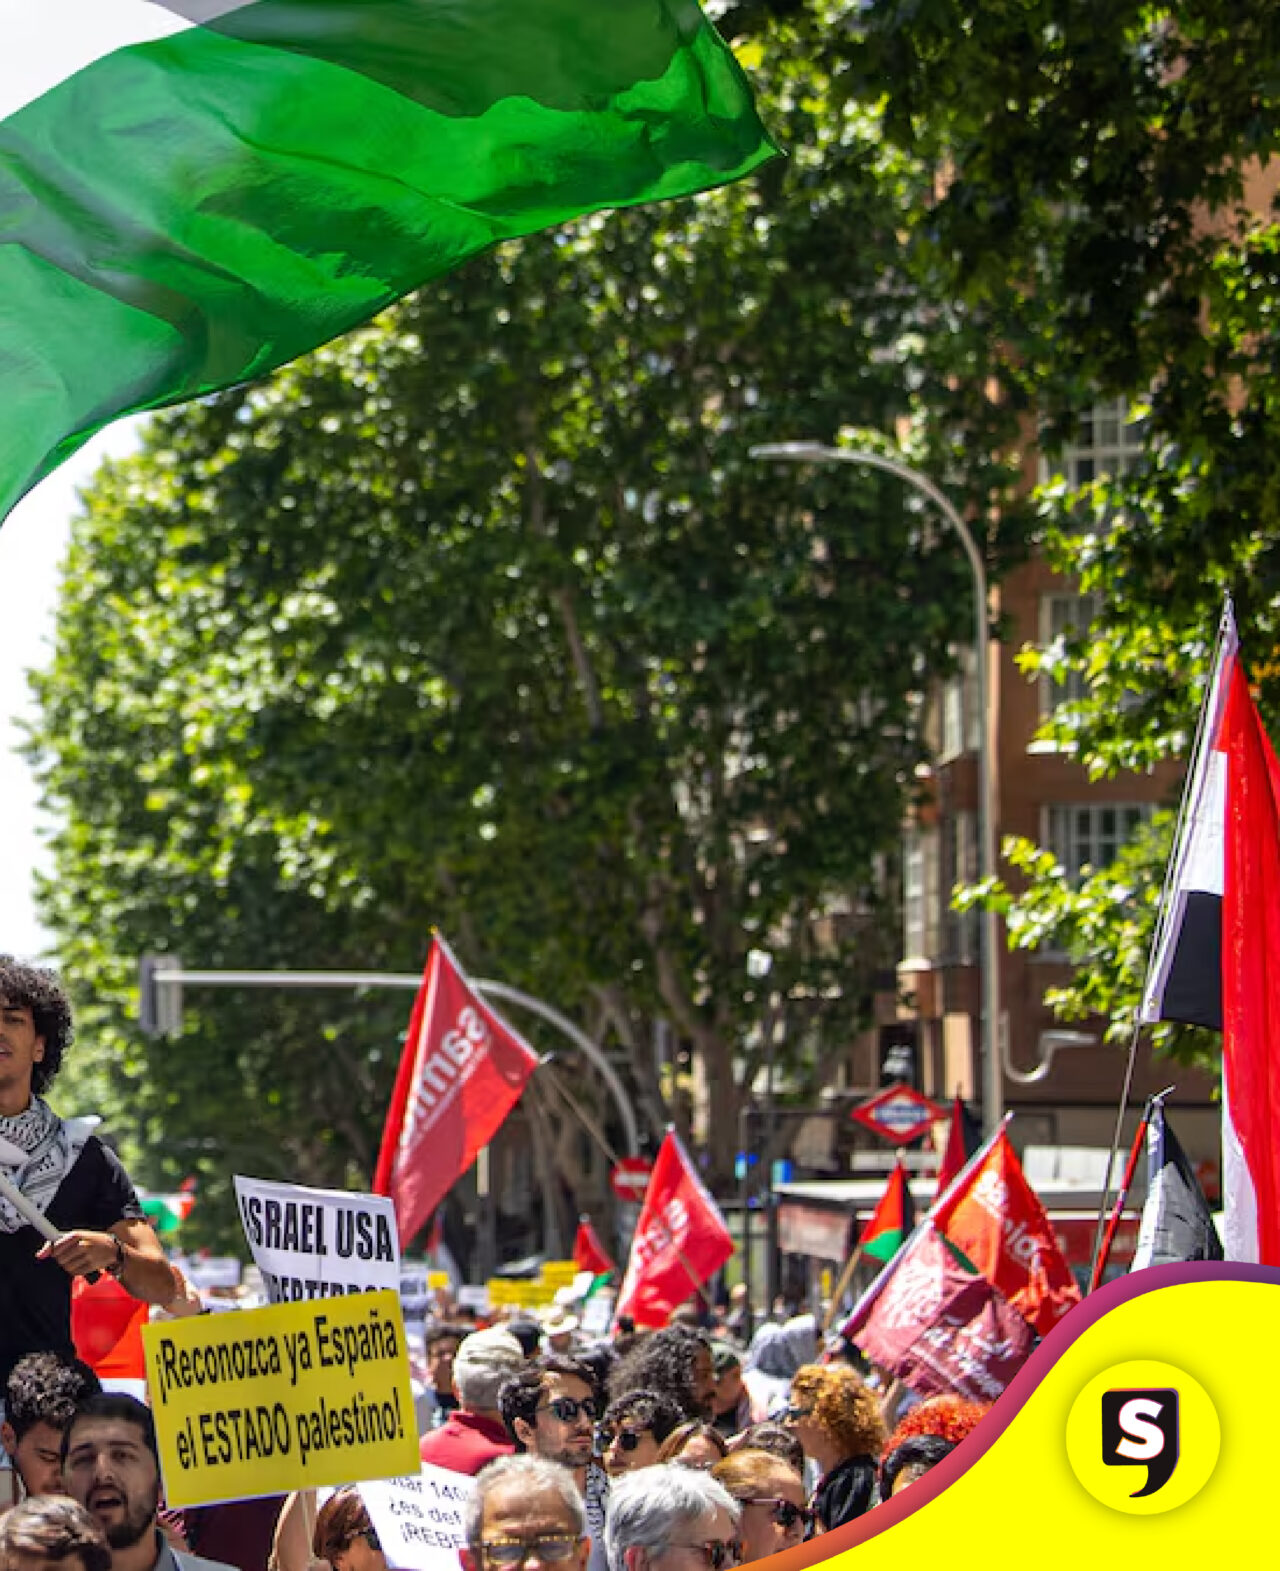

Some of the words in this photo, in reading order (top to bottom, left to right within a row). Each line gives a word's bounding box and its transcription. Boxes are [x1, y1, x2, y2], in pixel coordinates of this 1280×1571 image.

[241, 1196, 328, 1256] ISRAEL
[336, 1208, 394, 1262] USA
[156, 1335, 282, 1405] ¡Reconozca
[284, 1331, 312, 1386] ya
[314, 1310, 398, 1378] España
[176, 1416, 198, 1469] el
[199, 1402, 290, 1465] ESTADO
[296, 1387, 404, 1466] palestino!
